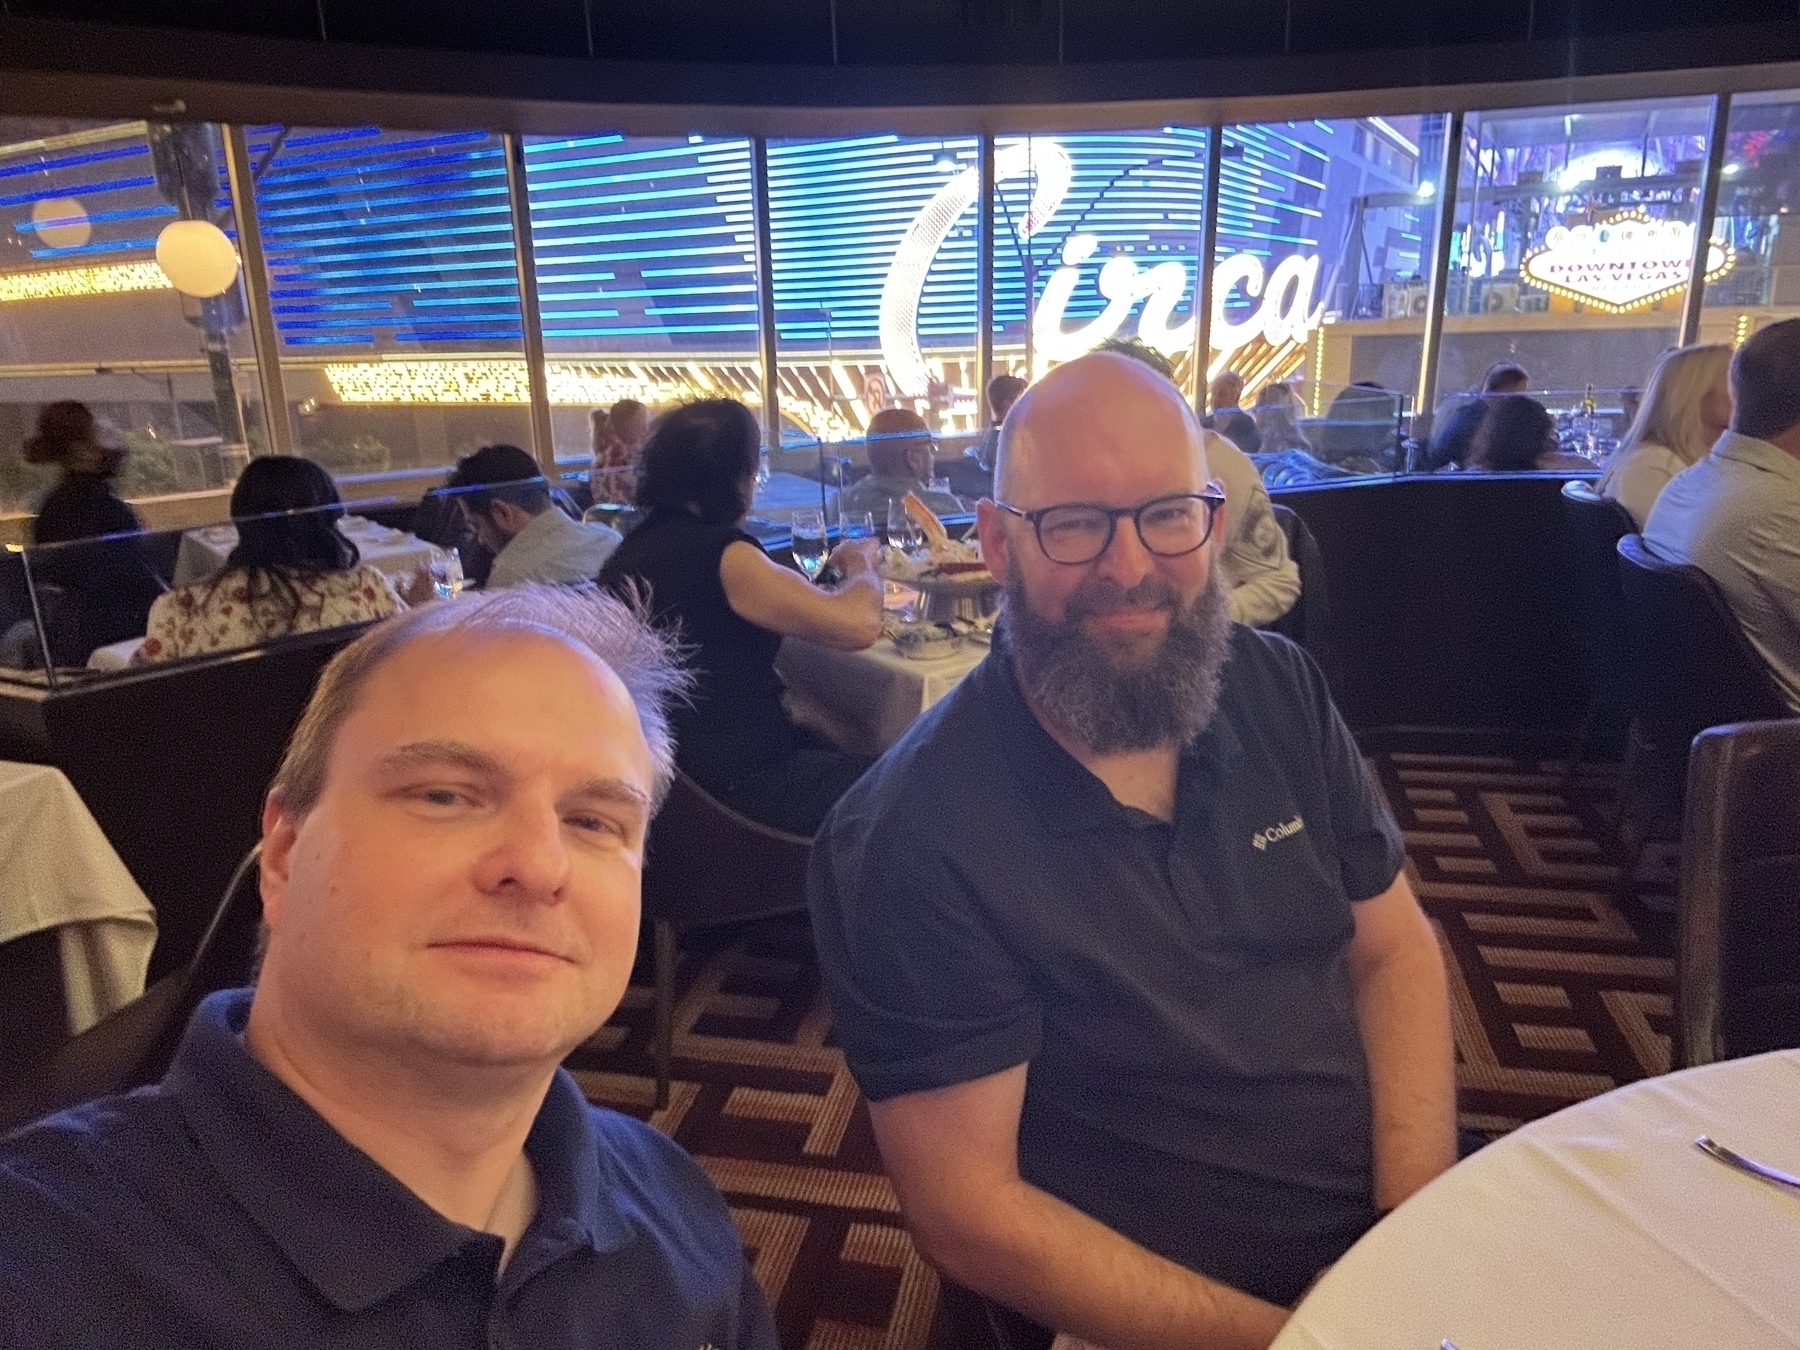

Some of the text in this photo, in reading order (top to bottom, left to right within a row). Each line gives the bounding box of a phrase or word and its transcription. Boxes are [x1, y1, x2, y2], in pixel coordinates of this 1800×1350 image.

[879, 140, 1325, 398] Circa
[1565, 271, 1681, 283] LAS VEGAS
